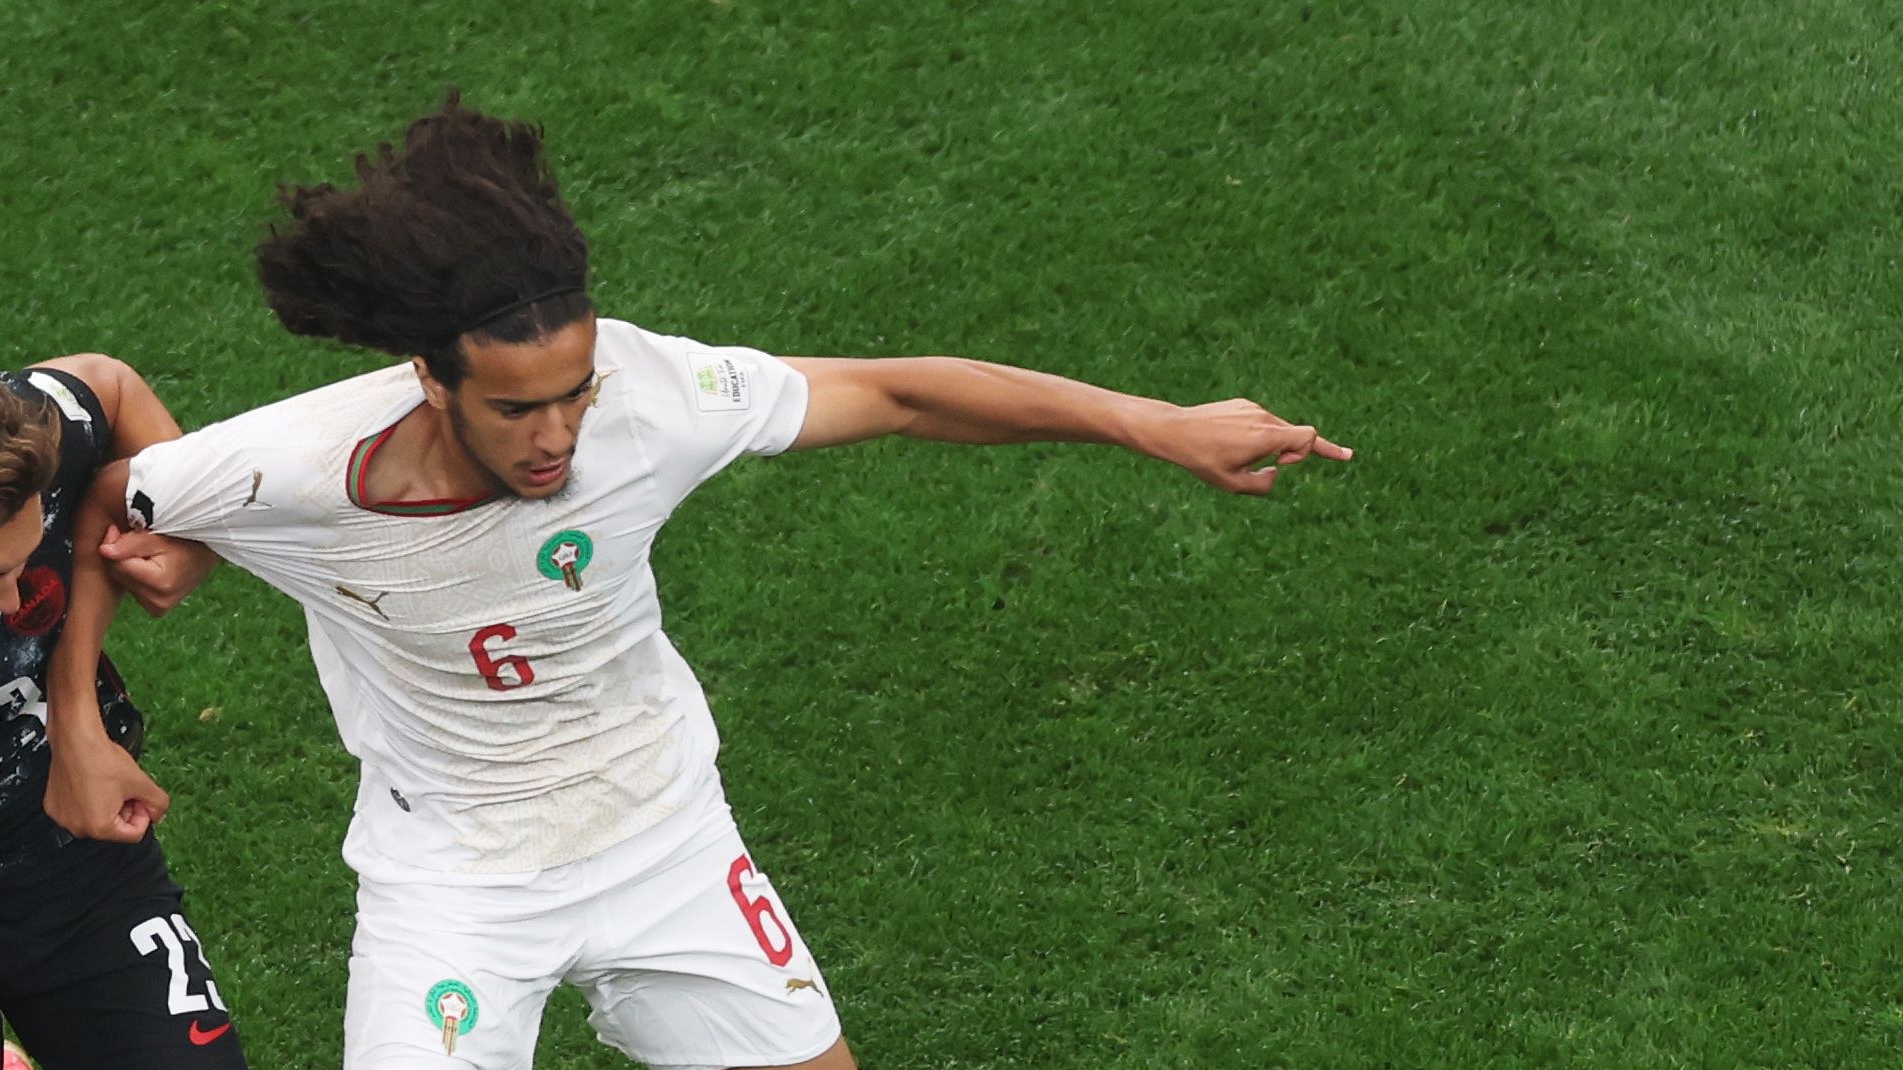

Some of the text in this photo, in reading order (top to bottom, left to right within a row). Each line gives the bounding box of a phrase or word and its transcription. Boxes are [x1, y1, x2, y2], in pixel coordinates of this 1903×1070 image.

[724, 359, 741, 403] EDUCATION
[468, 623, 535, 691] 6
[727, 853, 793, 967] 6
